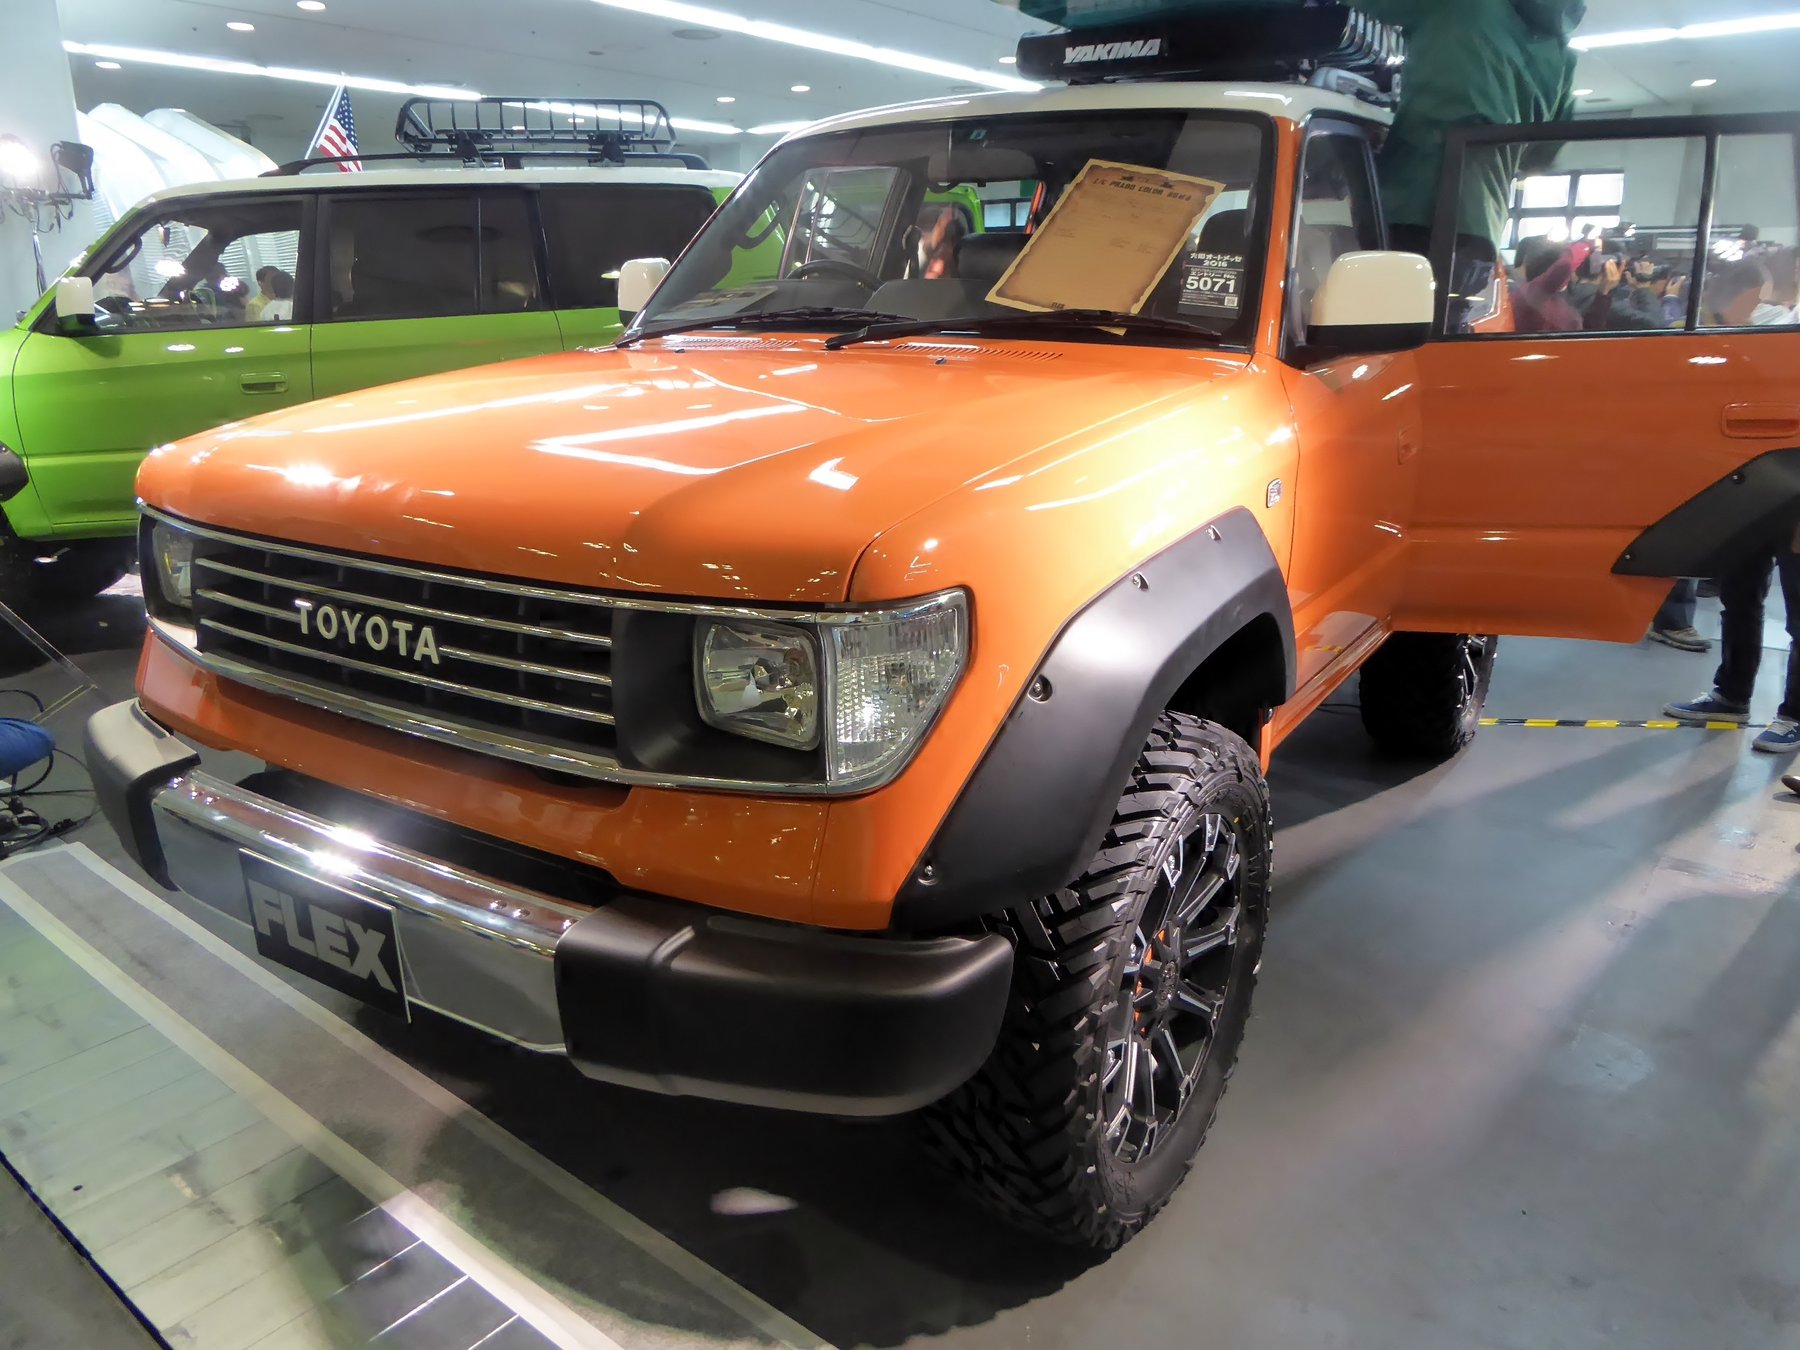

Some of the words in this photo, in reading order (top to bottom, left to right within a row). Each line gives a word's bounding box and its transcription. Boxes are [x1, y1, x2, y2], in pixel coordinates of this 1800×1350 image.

[1063, 39, 1161, 64] YAKIMA
[1186, 276, 1235, 293] 5071
[295, 599, 441, 665] TOYOTA
[248, 878, 398, 994] FLEX
